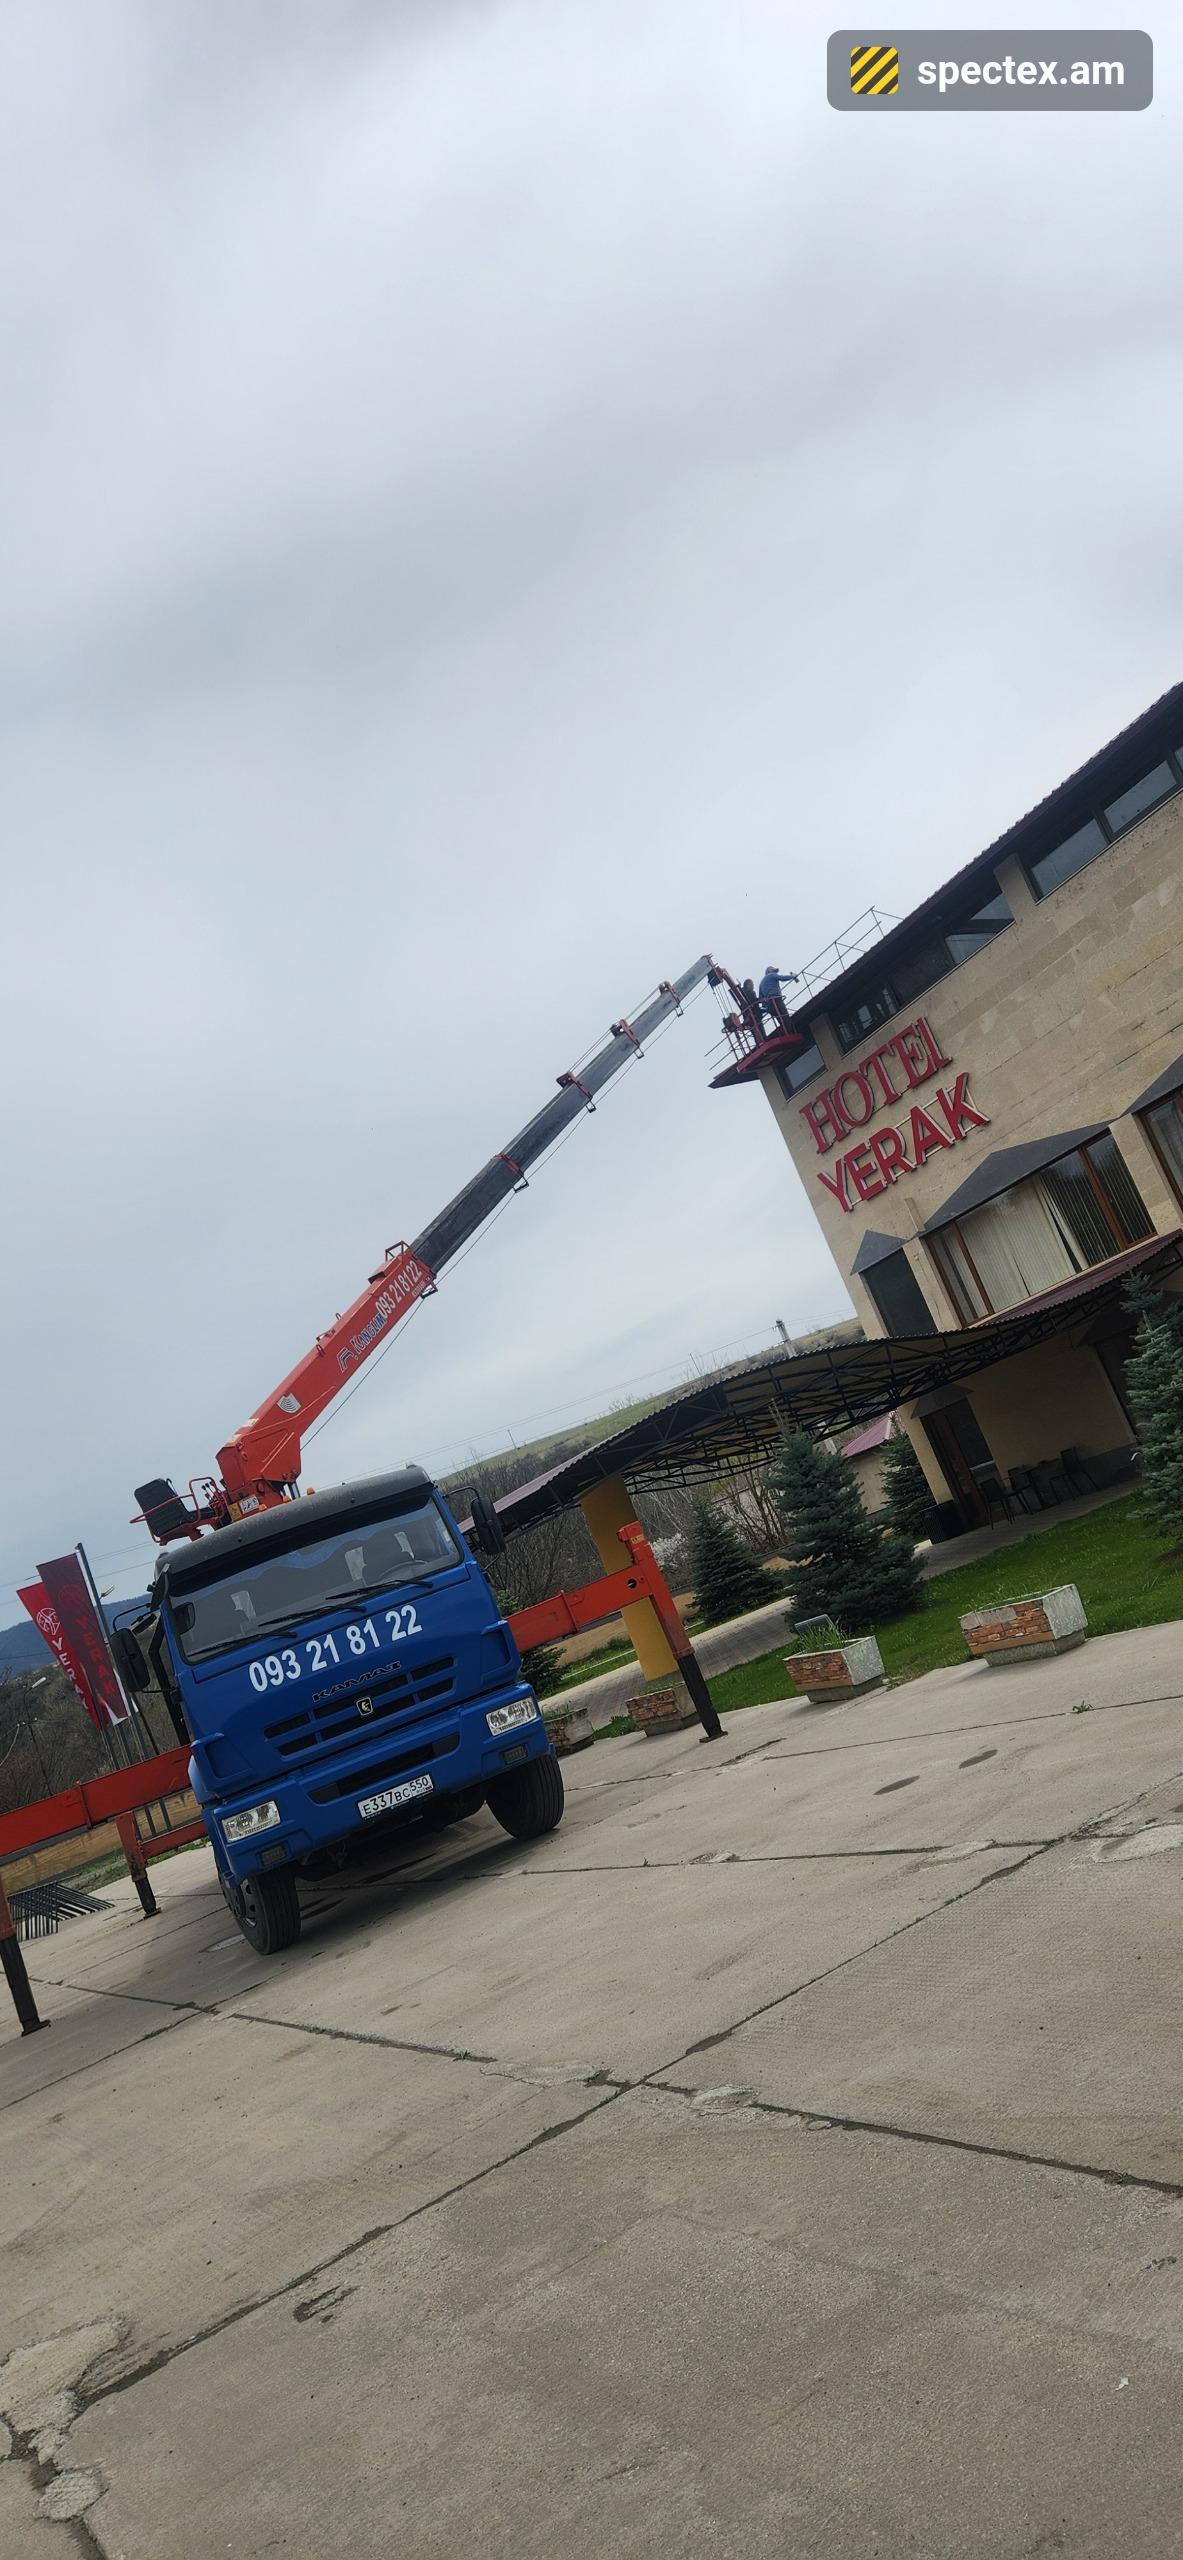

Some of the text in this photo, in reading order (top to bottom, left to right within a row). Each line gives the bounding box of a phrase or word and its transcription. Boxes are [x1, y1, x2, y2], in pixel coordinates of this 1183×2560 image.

[816, 1072, 992, 1213] YERAK
[375, 1292, 396, 1319] 093
[249, 1604, 422, 1692] 093 21 81 22
[410, 1776, 429, 1792] 550
